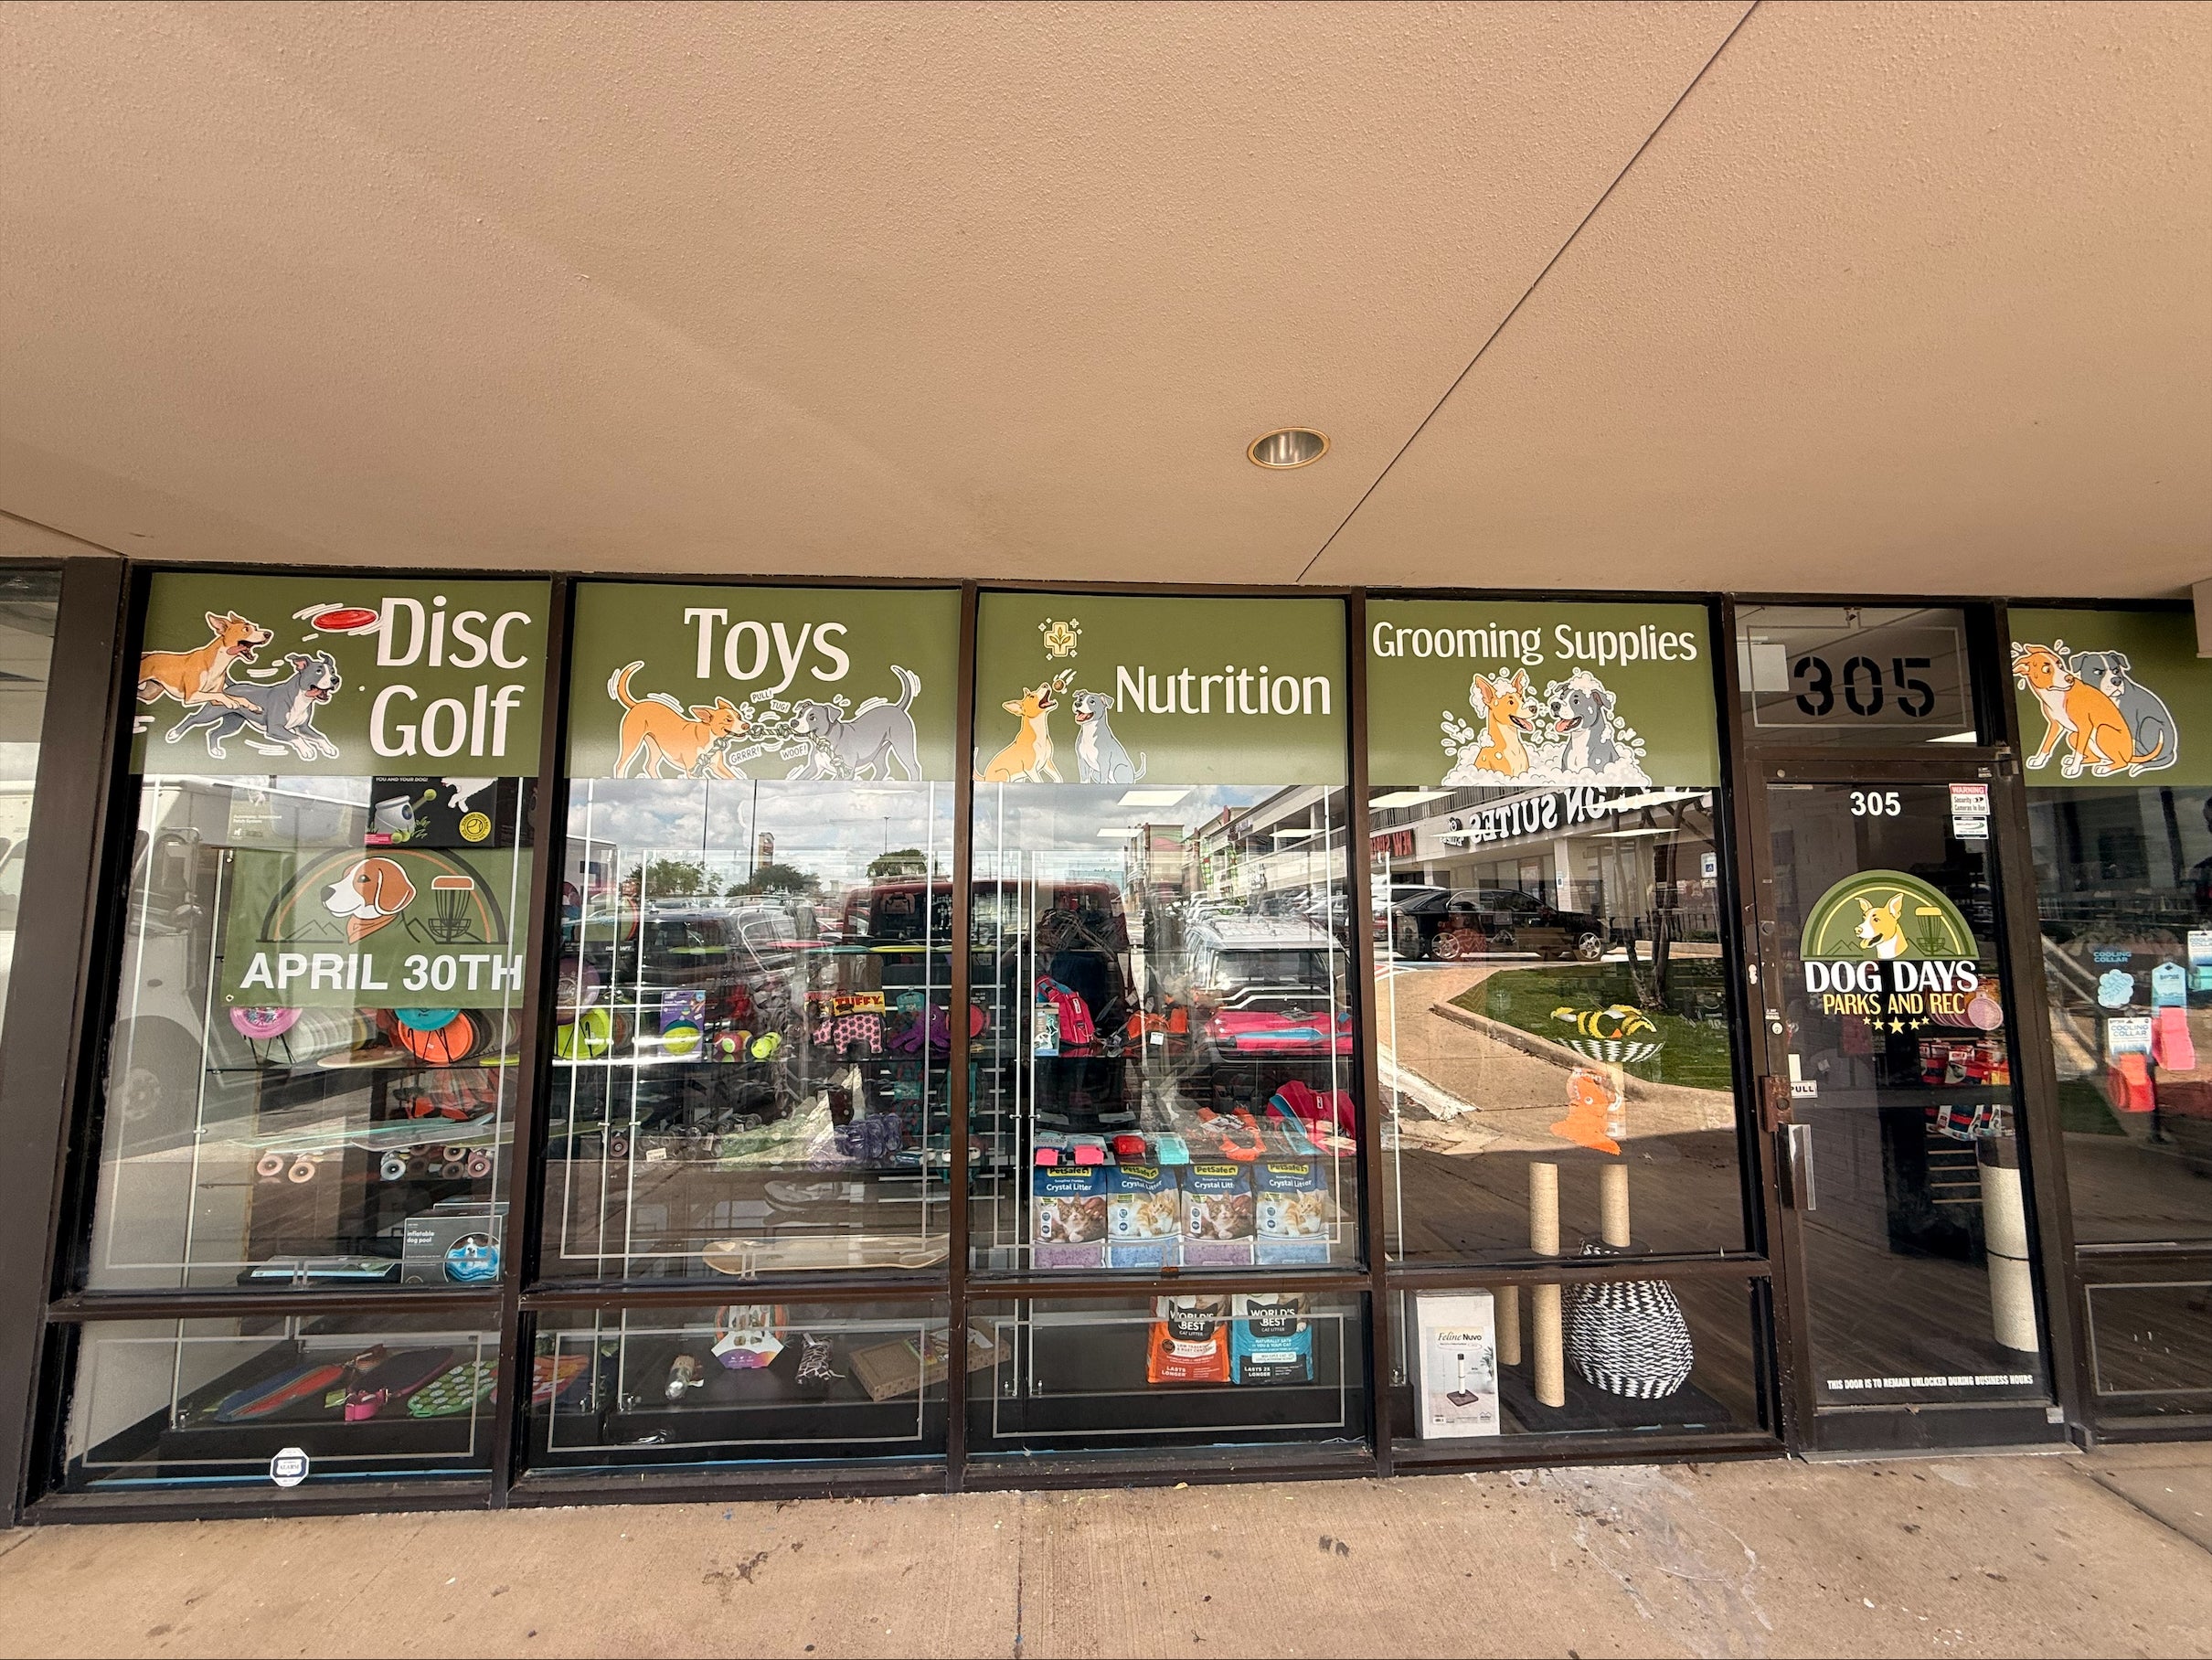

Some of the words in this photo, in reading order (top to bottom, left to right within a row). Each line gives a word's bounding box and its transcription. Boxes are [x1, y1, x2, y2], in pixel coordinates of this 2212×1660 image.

[377, 595, 531, 669] Disc
[1372, 621, 1542, 665] Grooming
[1555, 623, 1697, 665] Supplies
[683, 607, 850, 694] Toys
[1116, 665, 1330, 716] Nutrition
[1793, 656, 1935, 718] 305
[752, 690, 772, 701] PULL!
[771, 702, 790, 711] TUG!
[369, 684, 526, 758] Golf
[731, 746, 760, 763] GRRRR!
[782, 744, 807, 759] WOOF!
[1850, 792, 1901, 816] 305
[239, 952, 389, 992] APRIL
[402, 953, 524, 992] 30TH
[1804, 961, 1883, 993] DOG
[1892, 960, 1979, 993] DAYS
[835, 995, 880, 1006] TUFFY
[1823, 994, 1882, 1016] PARKS
[1888, 994, 1923, 1015] AND
[1930, 994, 1965, 1015] REC
[1196, 1165, 1228, 1174] PetSafe
[1046, 1183, 1072, 1192] Crystal
[1073, 1183, 1092, 1191] Litter
[1121, 1180, 1145, 1189] Crystal
[1144, 1180, 1163, 1191] Litter
[1269, 1179, 1293, 1187] Crystal
[1250, 1308, 1295, 1316] WORLD'S
[1180, 1321, 1206, 1332] BEST
[1261, 1317, 1287, 1327] BEST
[1438, 1331, 1462, 1342] Feline
[1827, 1379, 1844, 1389] THIS
[1845, 1379, 1864, 1389] DOOR
[1865, 1378, 1873, 1389] IS
[1873, 1378, 1882, 1389] TO
[1883, 1378, 1910, 1388] REMAIN
[1910, 1377, 1947, 1388] UNLOCKED
[1948, 1376, 1974, 1387] DURING
[1974, 1376, 2009, 1386] BUSINESS
[2009, 1375, 2034, 1385] HOURS
